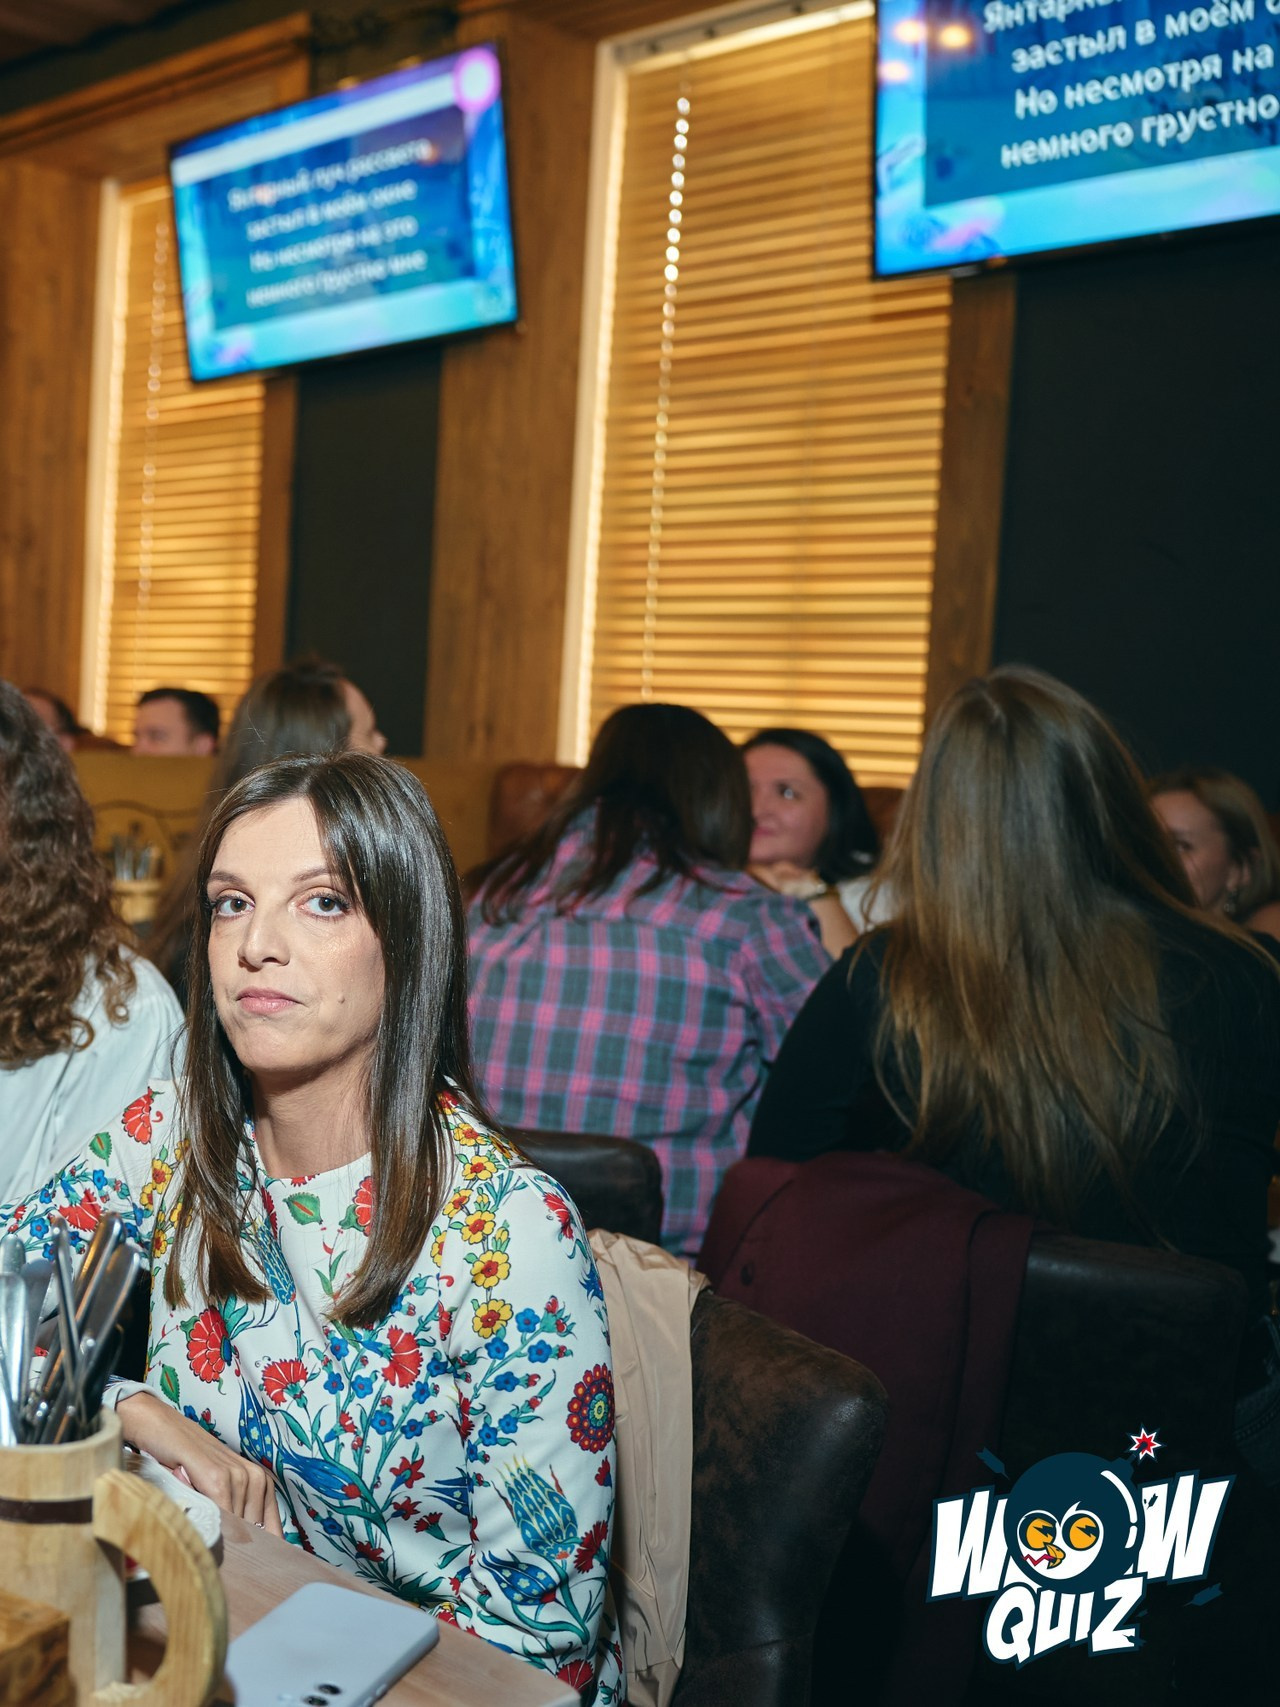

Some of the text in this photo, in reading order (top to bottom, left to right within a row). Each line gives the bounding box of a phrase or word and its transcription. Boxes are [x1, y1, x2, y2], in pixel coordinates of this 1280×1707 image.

[983, 0, 1122, 33] Янтар
[1011, 0, 1255, 73] застыл в моём
[1015, 43, 1274, 120] Но несмотря на
[1001, 93, 1280, 169] немного грустно
